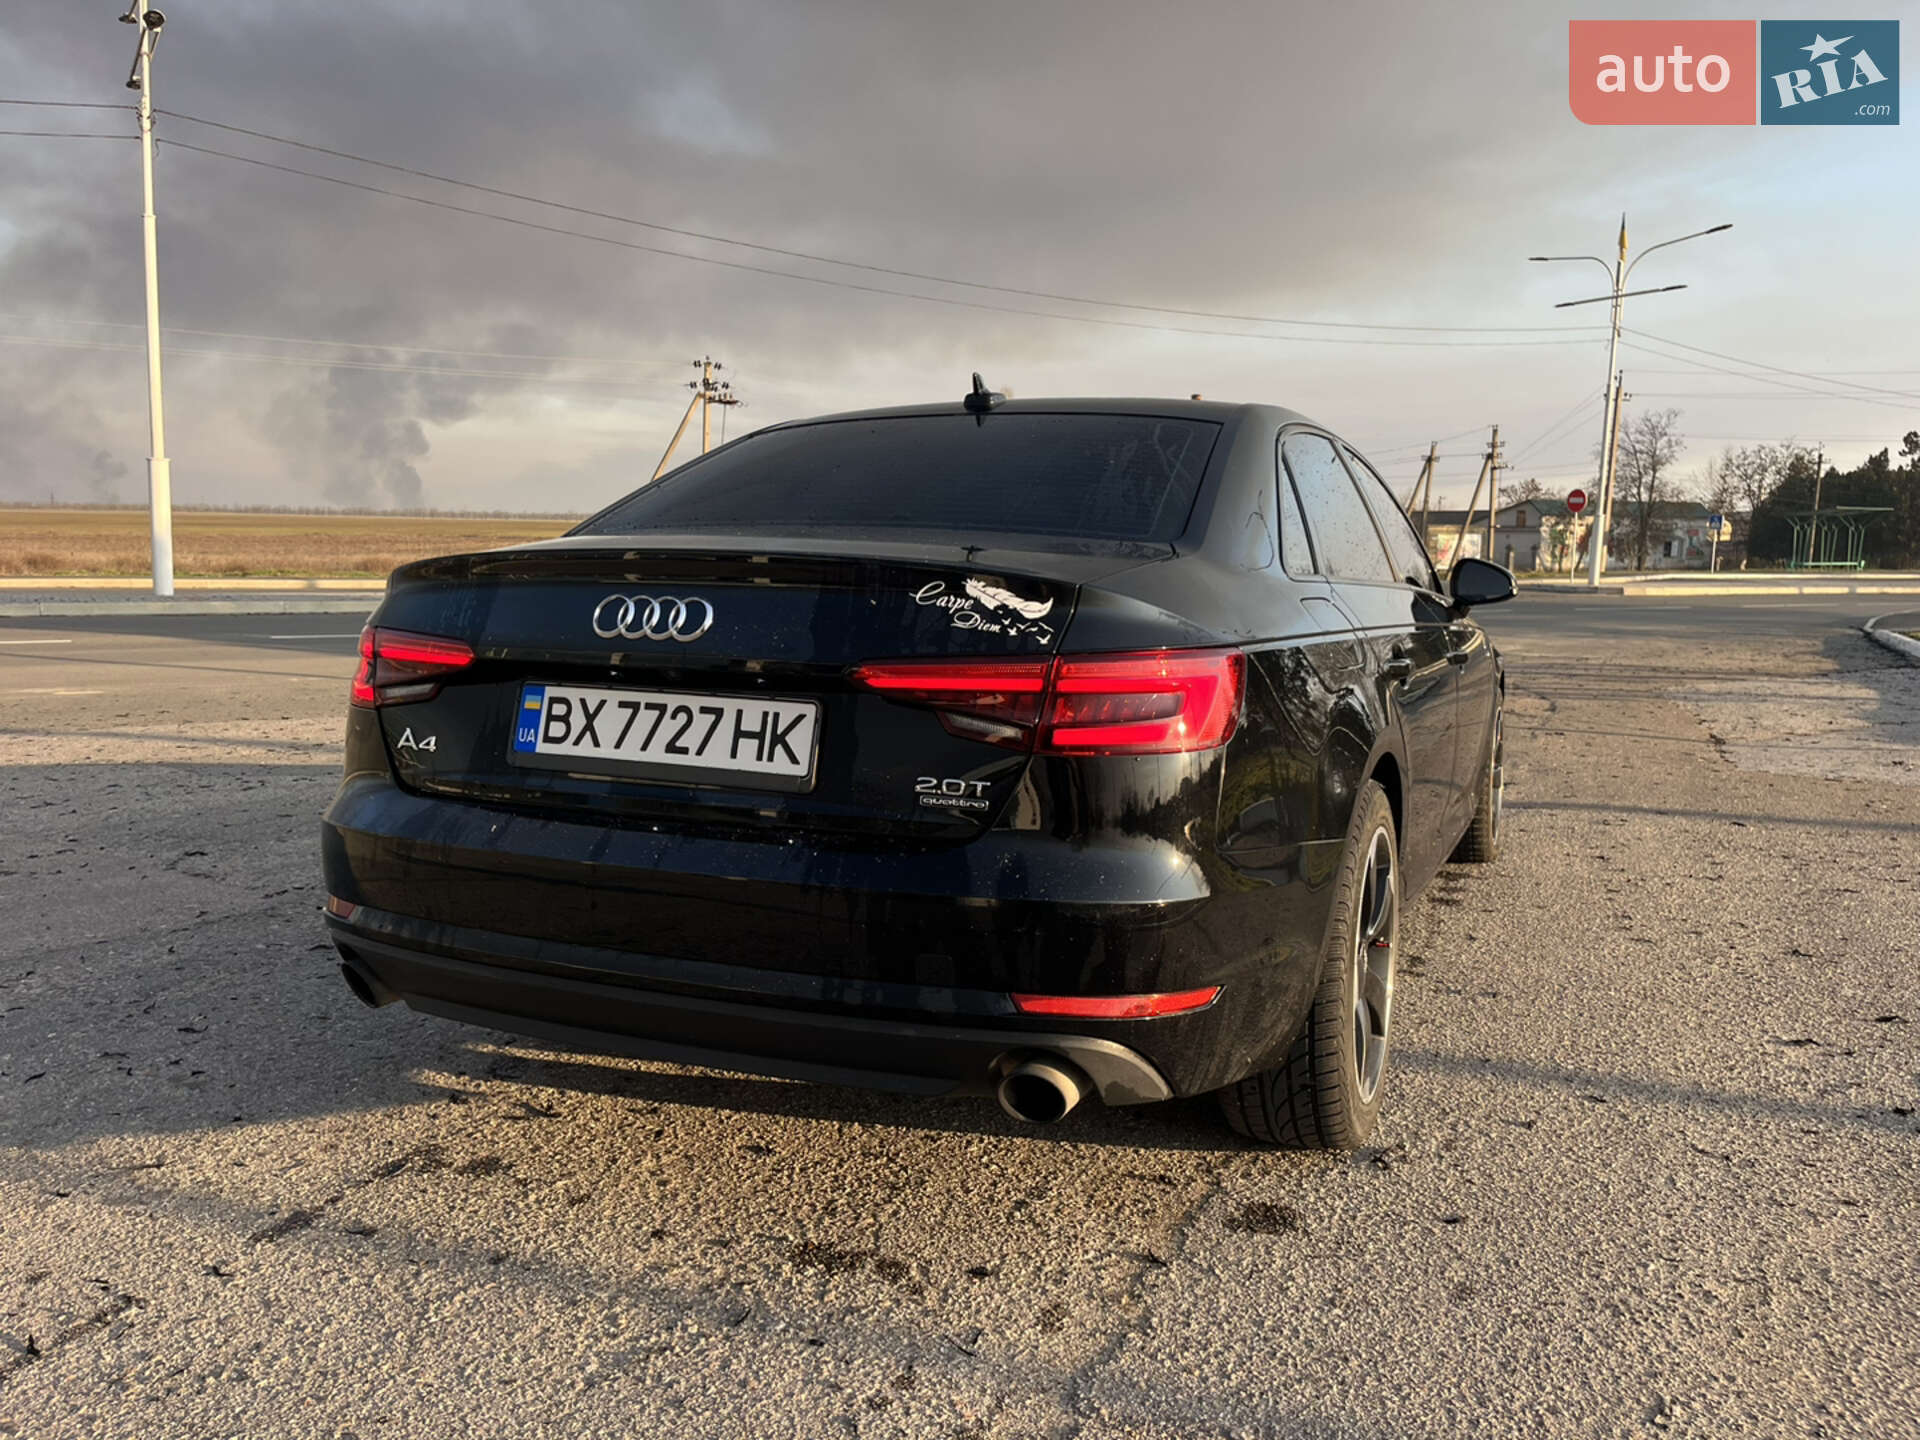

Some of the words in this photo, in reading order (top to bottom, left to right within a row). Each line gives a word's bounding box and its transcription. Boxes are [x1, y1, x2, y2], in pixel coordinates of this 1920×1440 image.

[909, 581, 975, 614] Carpe
[950, 611, 1002, 633] Diem
[397, 727, 437, 753] A4
[518, 727, 536, 744] UA
[542, 696, 607, 748] BX
[613, 700, 725, 756] 7727
[730, 708, 808, 765] HK
[914, 776, 992, 797] 2.0T
[922, 796, 985, 809] quattro
